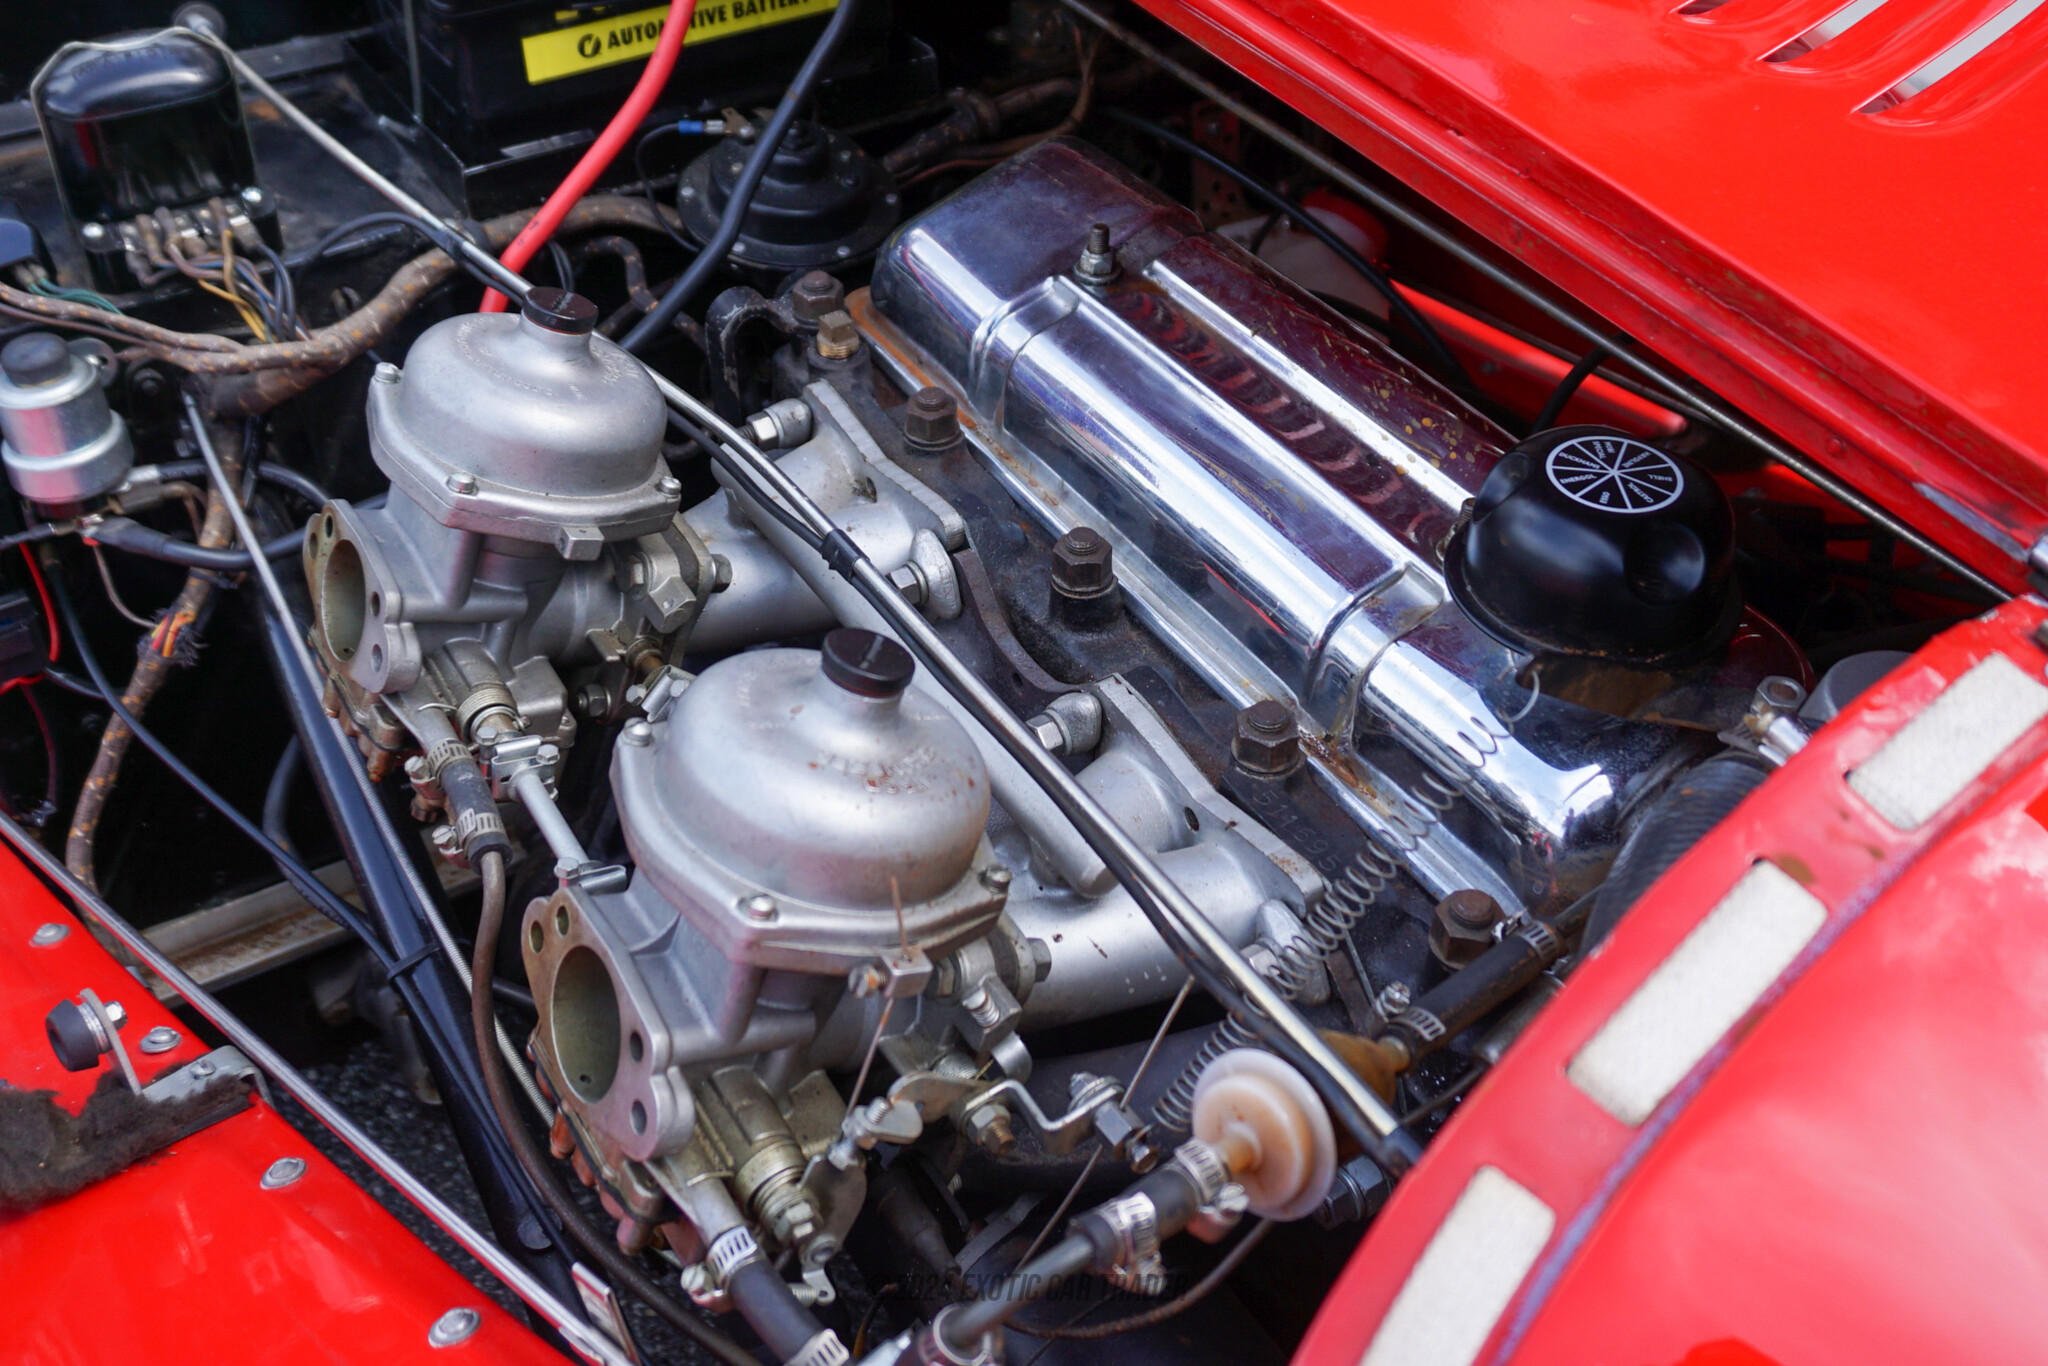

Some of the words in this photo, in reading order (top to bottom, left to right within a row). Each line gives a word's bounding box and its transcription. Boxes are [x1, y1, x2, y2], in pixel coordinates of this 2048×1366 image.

[607, 5, 727, 49] AUTOTIVE
[732, 0, 809, 19] BATT
[1558, 451, 1601, 470] DUCKHAMS
[1560, 473, 1598, 485] ENERGOL
[1648, 474, 1673, 482] SHELL
[1627, 482, 1654, 504] CASTROL
